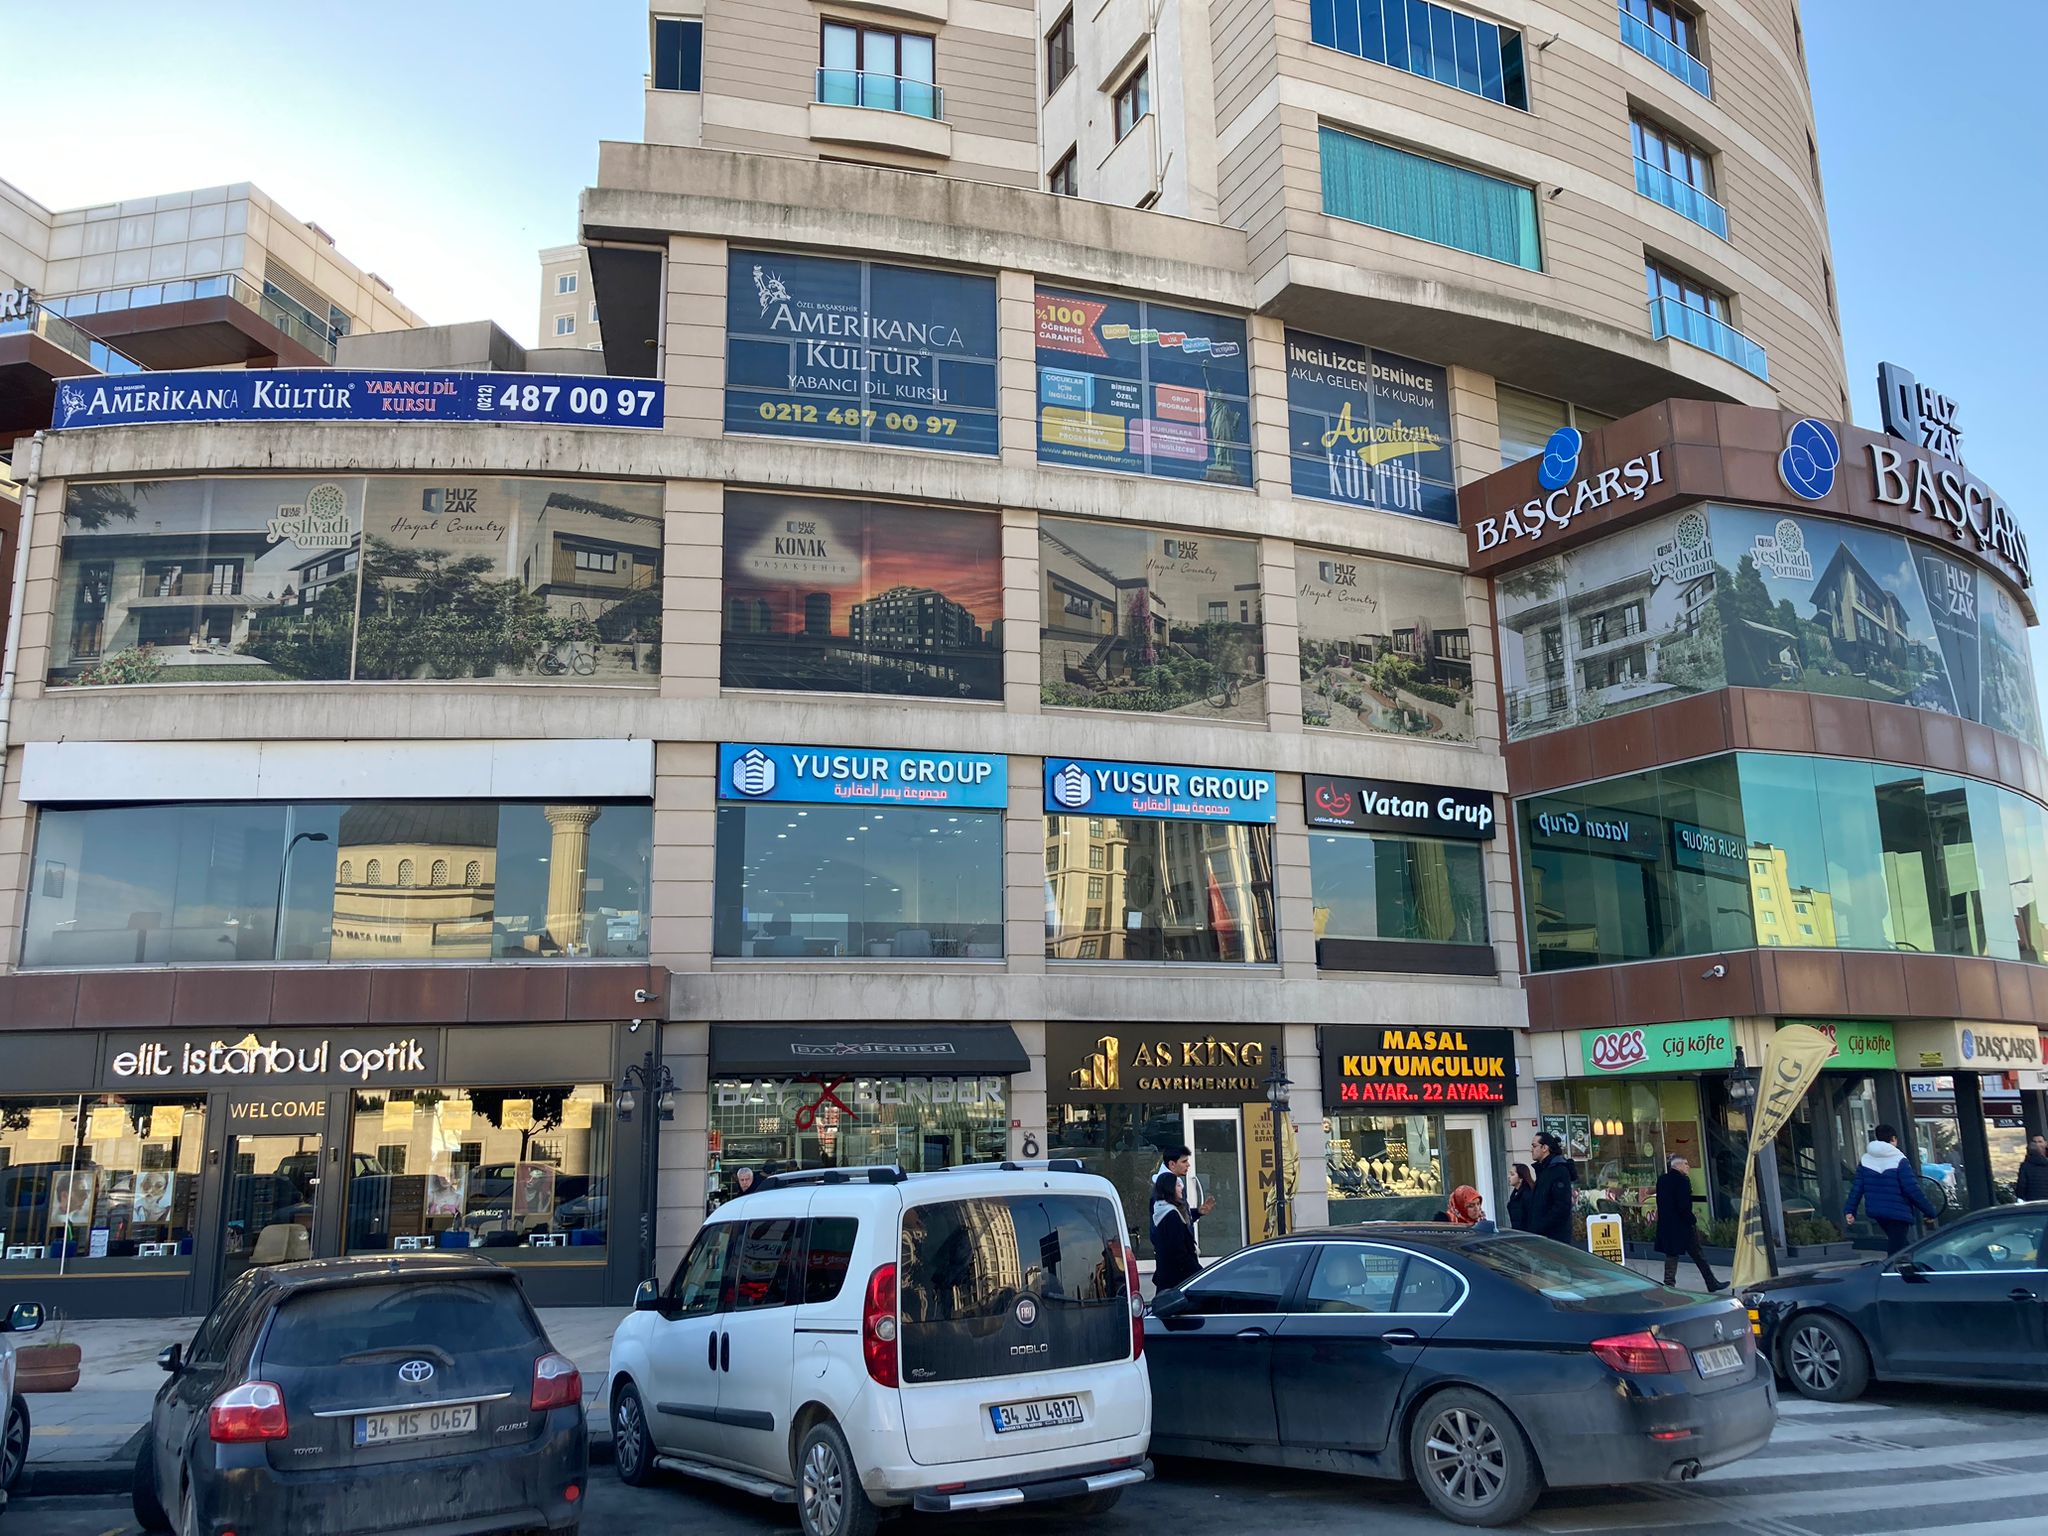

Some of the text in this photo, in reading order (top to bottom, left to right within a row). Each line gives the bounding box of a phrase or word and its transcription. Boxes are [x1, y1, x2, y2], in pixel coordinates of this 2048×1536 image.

[797, 301, 815, 310] ÖZEL
[1036, 305, 1086, 326] %100
[770, 303, 964, 348] AMERİKANCA
[1041, 322, 1082, 335] ÖĞRENME
[1039, 332, 1085, 344] GARANTİSİ
[806, 339, 922, 377] KÜLTÜR
[1290, 343, 1433, 392] İNGİLİZCE DENİNCE
[365, 378, 457, 395] YABANCI DİL
[788, 375, 947, 401] YABANCI DİL KURSU
[1291, 367, 1324, 383] AKLA
[1326, 375, 1368, 392] GELEN
[1392, 390, 1434, 409] KURUM
[87, 380, 351, 415] AMERİKANCA KÜLTÜR
[382, 398, 436, 412] KURSU
[477, 384, 495, 411] (0212)
[500, 384, 656, 417] 487 00 97
[1110, 400, 1140, 410] DERSLER
[1918, 383, 1963, 432] HUZ
[759, 402, 957, 435] 0212 487 00 97
[1920, 417, 1965, 465] ZAK
[446, 488, 478, 501] HUZ
[1475, 450, 1663, 553] BAŞÇARŞI
[444, 501, 477, 513] ZAK
[269, 516, 348, 540] yeşilvadi
[391, 517, 505, 541] Hayat Country
[798, 521, 816, 529] HUZ
[299, 535, 348, 546] orman
[775, 537, 827, 557] KONAK
[1178, 540, 1198, 551] HUZ
[1178, 550, 1198, 560] ZAK
[1651, 541, 1712, 577] yeşilvadi
[1146, 559, 1217, 582] Hayat Country
[1334, 563, 1356, 576] HUZ
[1675, 559, 1714, 580] orman
[1776, 566, 1811, 578] orman
[1945, 563, 1973, 597] HUZ
[1335, 574, 1357, 587] ZAK
[1300, 584, 1377, 613] Hayat Country
[1948, 589, 1976, 622] ZAK
[791, 754, 992, 784] YUSUR GROUP
[834, 782, 947, 802] مجموعة يسر العقارية
[1096, 769, 1269, 801] YUSUR GROUP
[1133, 798, 1230, 816] مجموعة يسر العقارية
[1361, 790, 1492, 830] Vatan Grup
[797, 1045, 946, 1054] BAY BERBER
[1382, 1030, 1468, 1050] MASAL
[1593, 1030, 1724, 1065] oses Çiğ köfte
[1848, 1035, 1864, 1054] Çiğ
[1867, 1034, 1891, 1055] köfte
[1975, 1035, 2037, 1062] BAŞÇARŞI
[113, 1038, 425, 1080] elit istanbul optik
[1132, 1042, 1173, 1067] AS
[1343, 1055, 1505, 1077] KUYUMCULUK
[717, 1076, 1004, 1106] BAY BERBER
[1138, 1075, 1259, 1090] GAYRİMENKUL
[1423, 1082, 1443, 1100] 22
[230, 1101, 326, 1119] WELCOME
[1021, 1306, 1031, 1318] FIAT
[1010, 1344, 1048, 1356] DOBLO
[1001, 1407, 1019, 1425] 34
[1026, 1404, 1040, 1421] JU
[1045, 1400, 1075, 1418] 4817
[368, 1408, 472, 1439] 34 MS 0467
[496, 1420, 528, 1432] AURIS
[294, 1447, 323, 1455] TOYOTA
